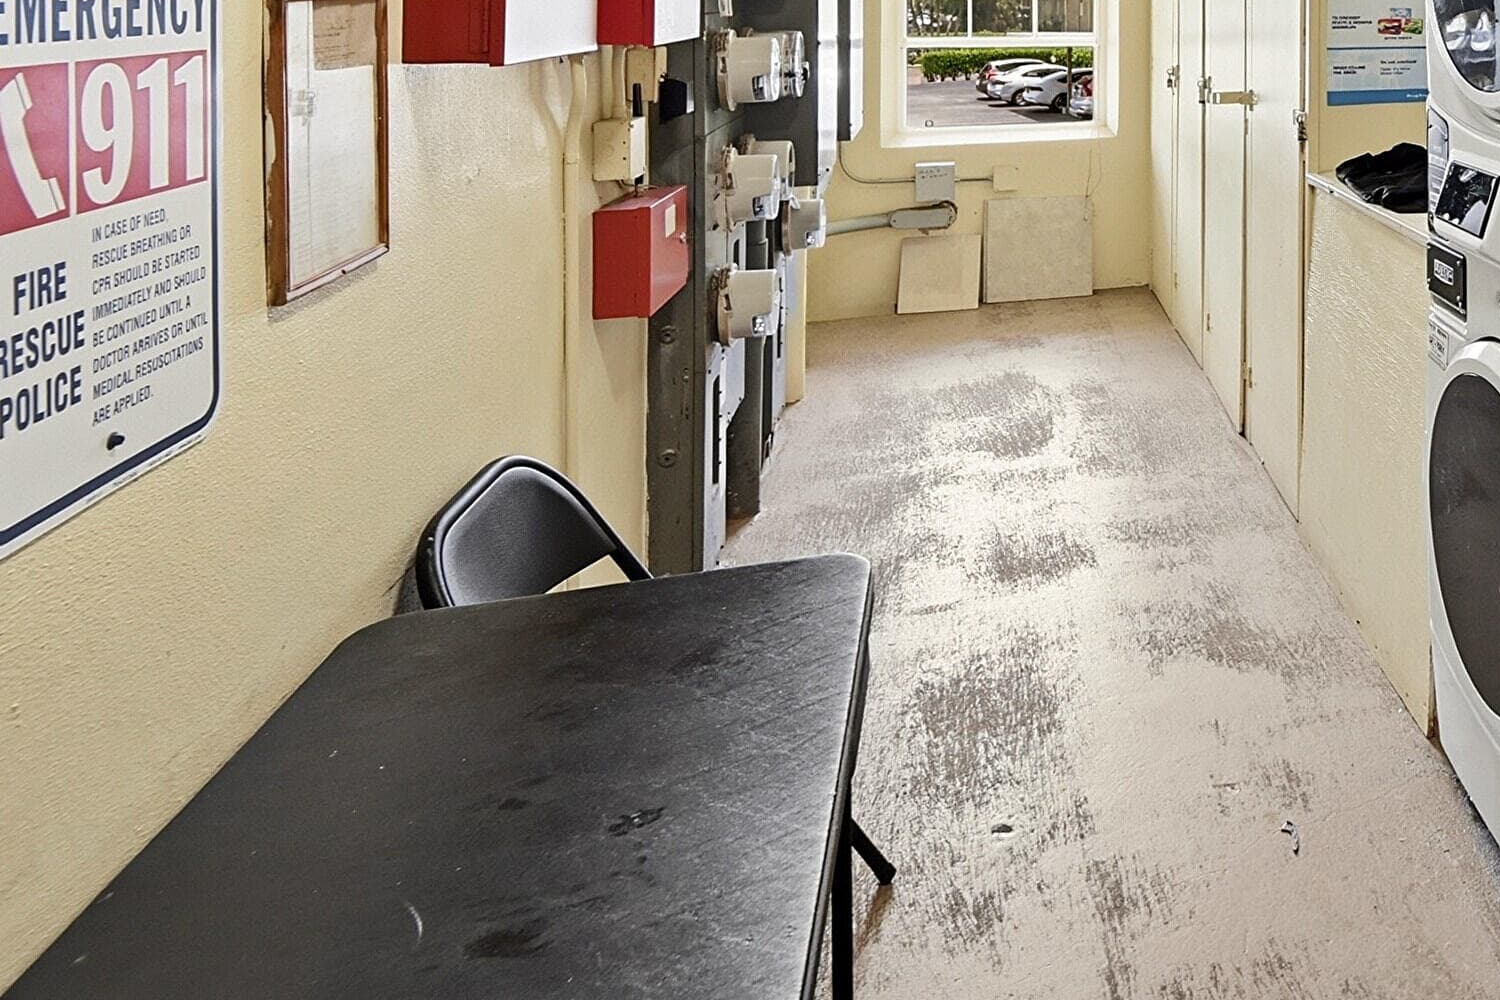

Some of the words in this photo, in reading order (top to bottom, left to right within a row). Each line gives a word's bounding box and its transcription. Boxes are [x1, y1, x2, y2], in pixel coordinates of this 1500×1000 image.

[81, 55, 205, 205] 911
[92, 227, 102, 243] IN
[104, 219, 127, 239] CASE
[129, 216, 141, 230] OF
[92, 245, 128, 269] RESCUE
[130, 228, 178, 255] BREATHING
[180, 224, 192, 240] OR
[13, 261, 67, 316] FIRE
[92, 278, 112, 295] CPR
[114, 263, 150, 288] SHOULD
[152, 257, 163, 273] BE
[164, 245, 200, 269] STARTED
[92, 286, 152, 321] IMMEDIATELY
[154, 279, 172, 298] AND
[174, 266, 207, 287] SHOULD
[0, 310, 85, 380] RESCUE
[93, 332, 104, 347] BE
[106, 309, 157, 343] CONTINUED
[159, 298, 184, 320] UNTIL
[93, 344, 130, 373] DOCTOR
[132, 328, 169, 355] ARRIVES
[171, 322, 183, 338] OR
[185, 312, 208, 333] UNTIL
[93, 369, 134, 400] MEDICAL
[135, 336, 204, 378] RESUSCITATIONS
[0, 365, 82, 440] POLICE
[92, 406, 111, 427] ARE
[113, 384, 154, 414] APPLIED.
